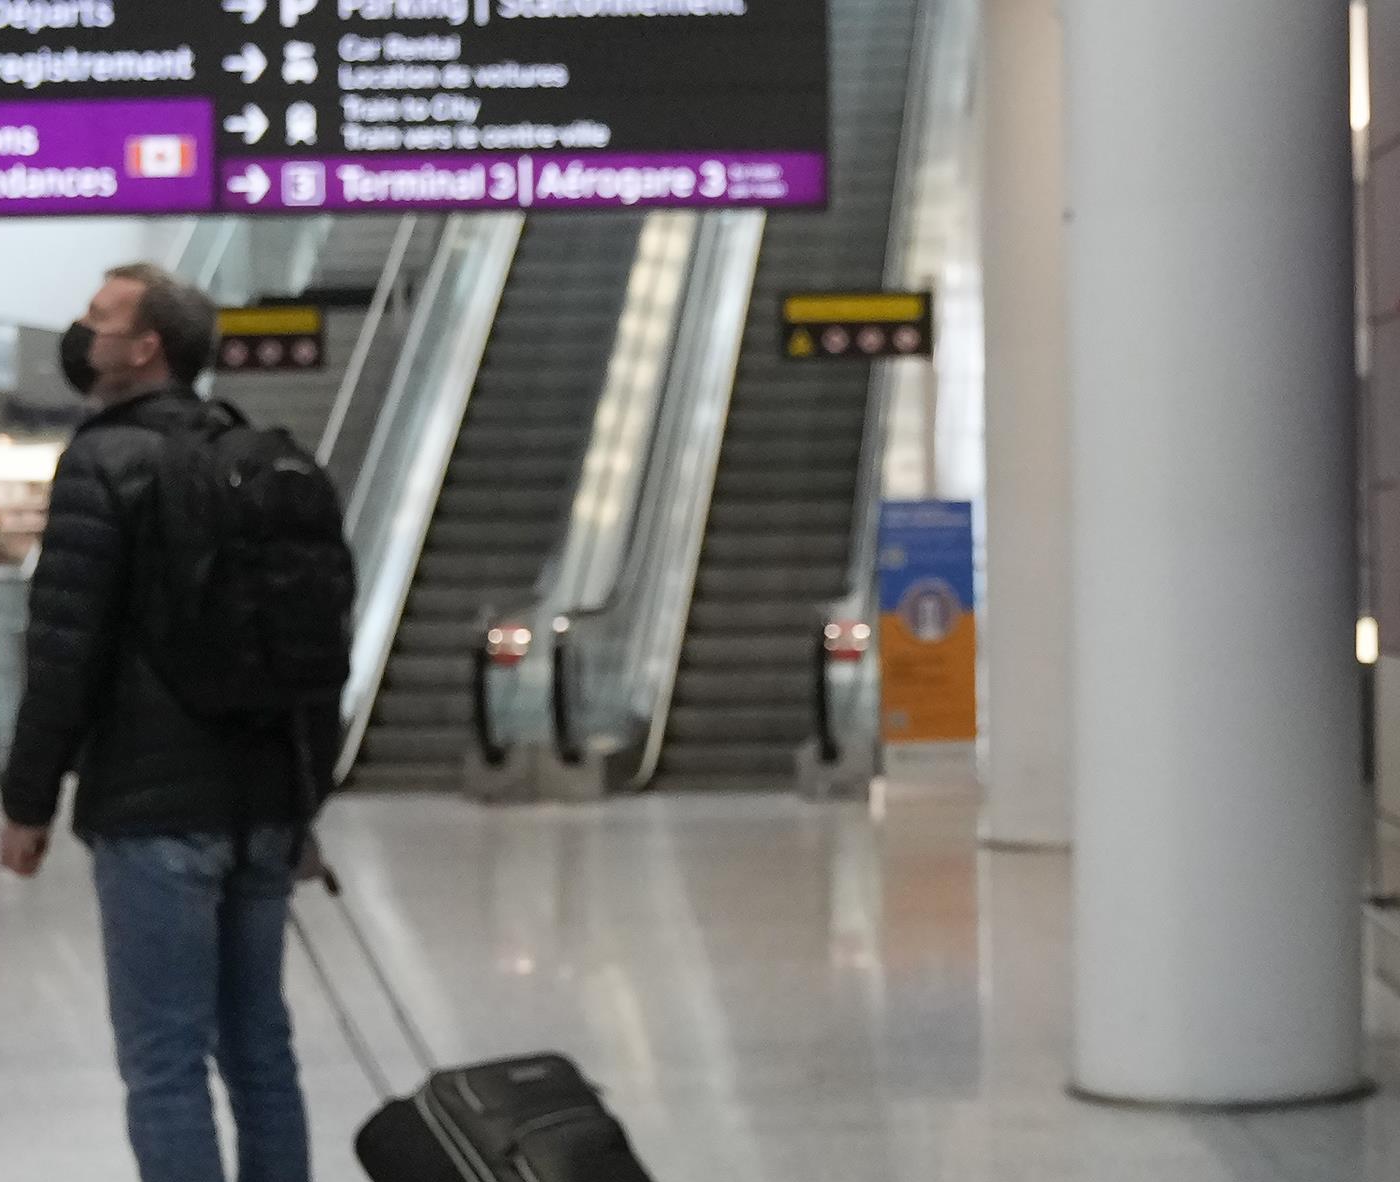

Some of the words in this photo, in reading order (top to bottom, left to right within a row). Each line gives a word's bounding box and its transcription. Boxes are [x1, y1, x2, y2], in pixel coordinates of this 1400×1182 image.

[336, 163, 485, 202] Terminal
[488, 162, 517, 200] 3
[536, 160, 696, 205] Aérogare
[699, 159, 727, 198] 3
